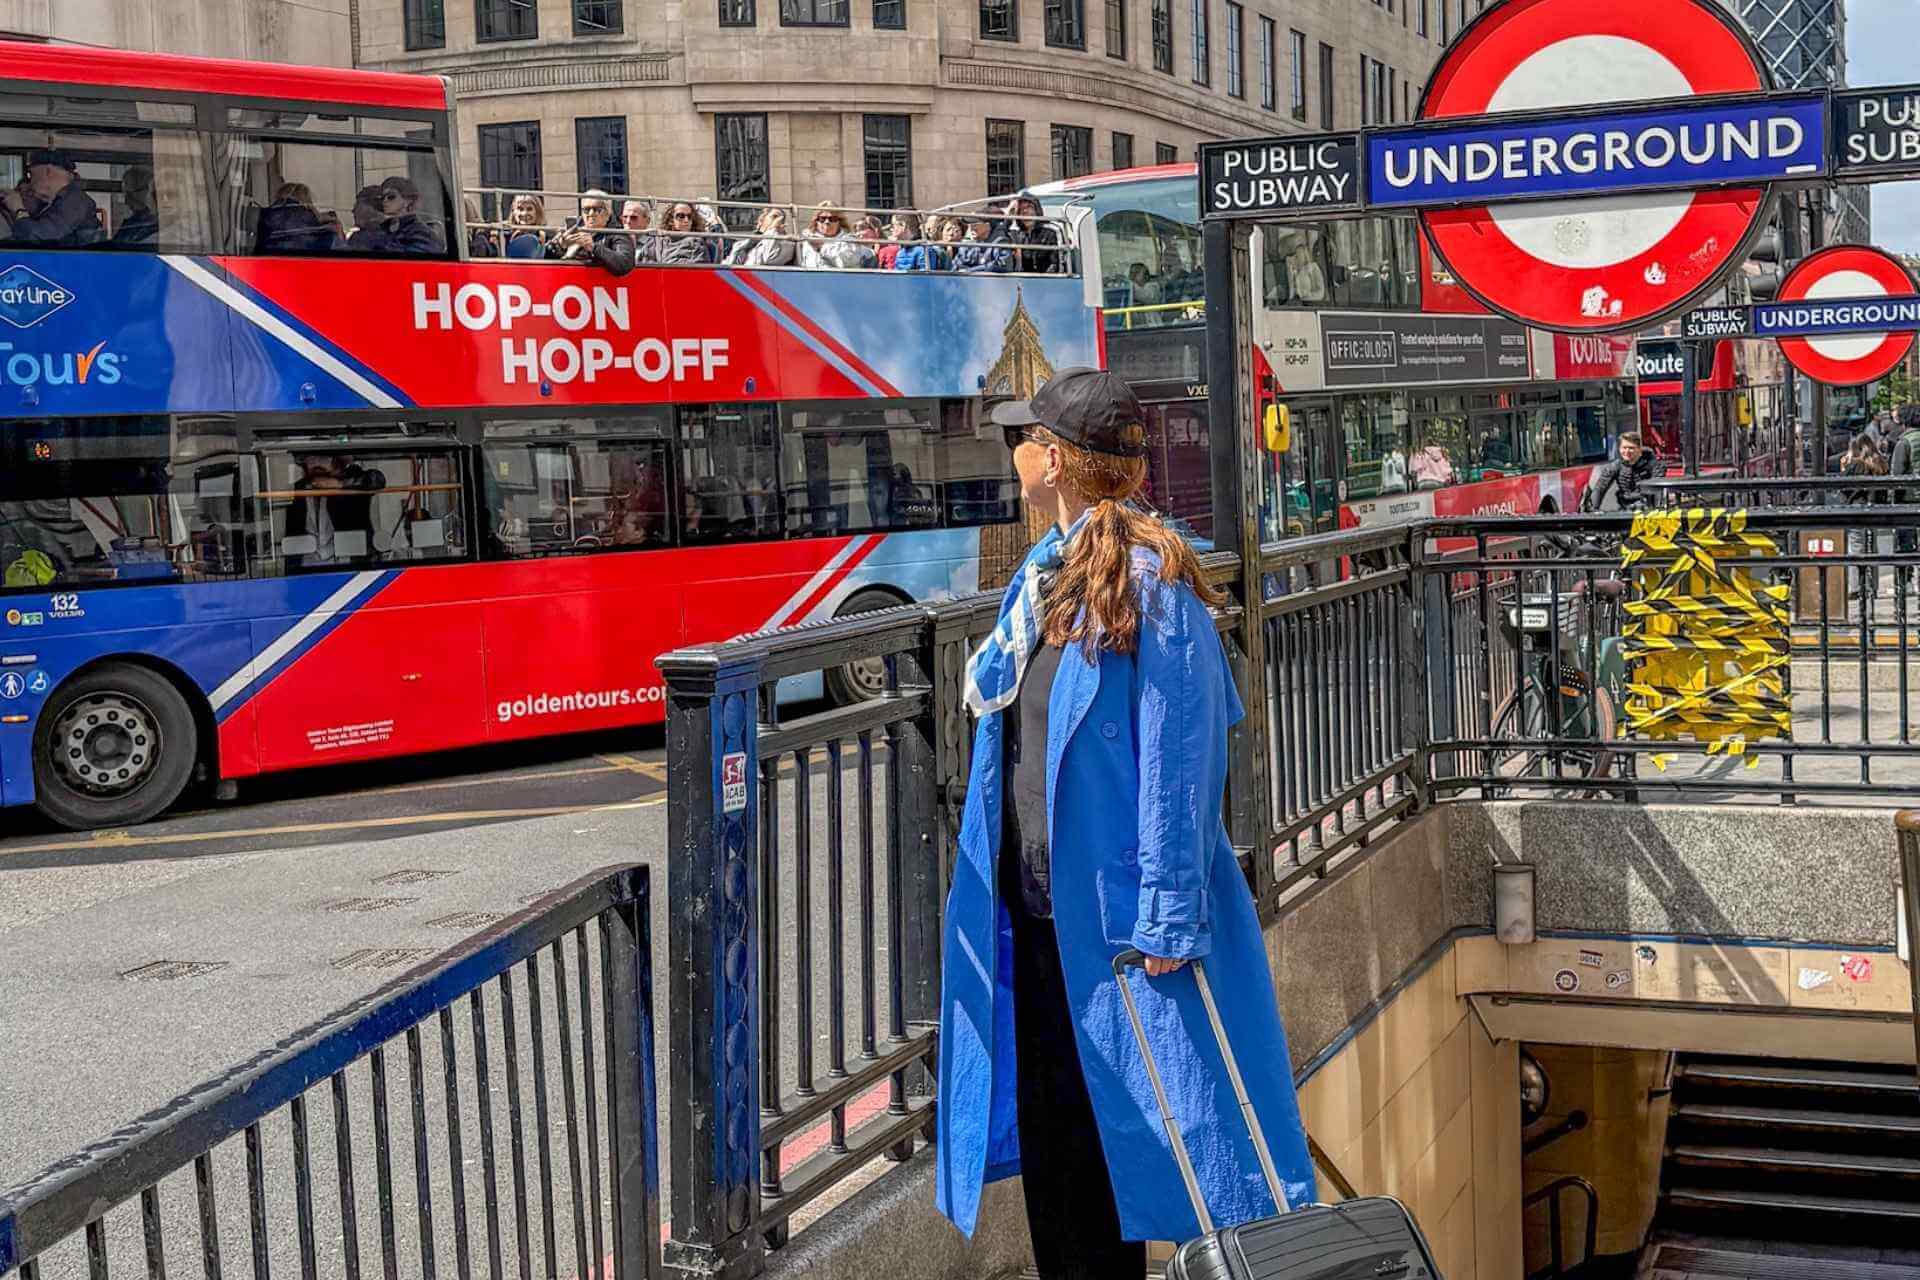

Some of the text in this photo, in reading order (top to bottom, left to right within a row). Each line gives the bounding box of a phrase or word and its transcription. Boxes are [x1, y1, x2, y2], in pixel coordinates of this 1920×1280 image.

[1223, 141, 1339, 177] PUBLIC
[1384, 117, 1802, 188] UNDERGROUND
[1214, 172, 1350, 209] SUBWAY
[412, 281, 631, 331] HOP-ON
[1691, 308, 1743, 323] PUBLIC
[1761, 303, 1920, 328] UNDERGROUN
[1687, 320, 1747, 336] SUBWAY
[501, 337, 729, 384] HOP-OFF
[1637, 353, 1684, 375] Route
[51, 594, 79, 611] 132
